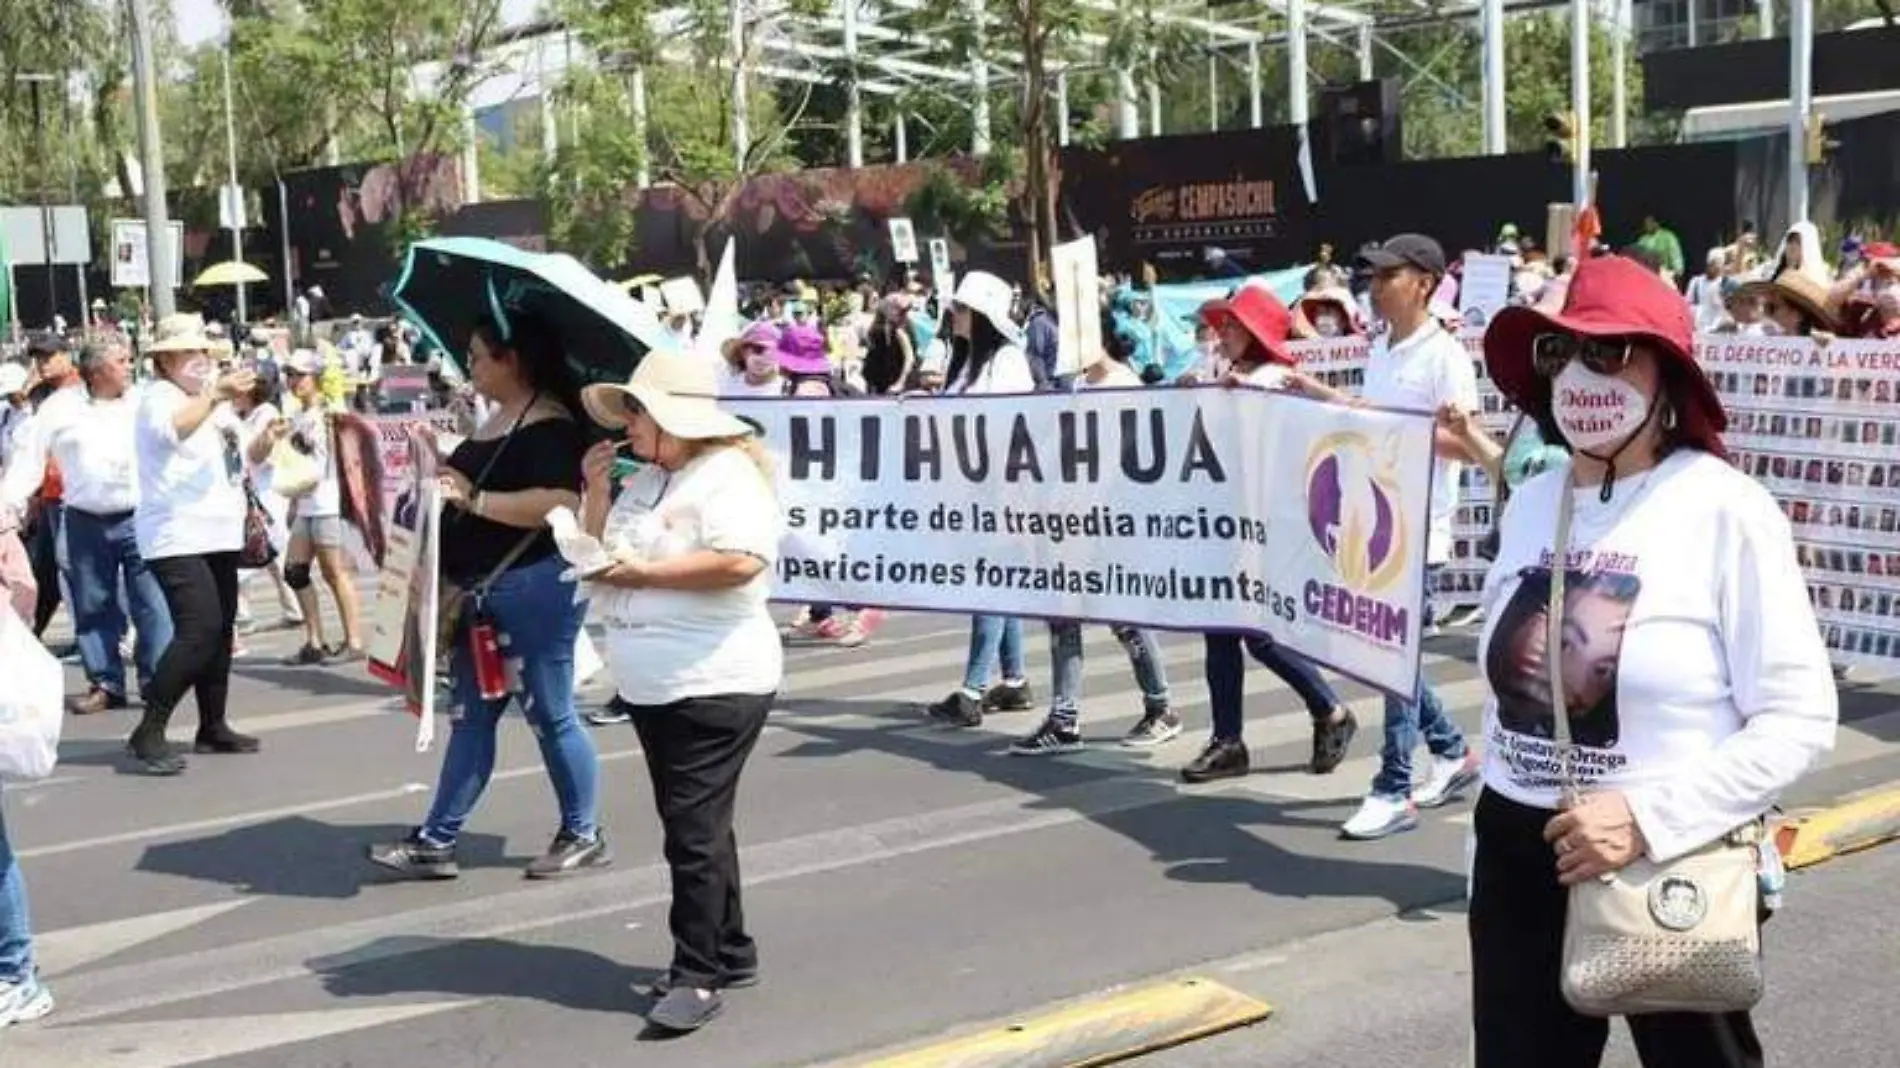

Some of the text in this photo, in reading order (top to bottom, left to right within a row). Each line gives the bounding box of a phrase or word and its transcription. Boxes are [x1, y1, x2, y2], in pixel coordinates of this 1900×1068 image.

[1724, 345, 1802, 366] DERECHO
[1808, 350, 1822, 367] A
[1828, 351, 1849, 369] LA
[818, 503, 920, 536] parte
[929, 502, 964, 531] de
[972, 503, 998, 533] la
[1004, 505, 1137, 544] tragedia
[1146, 506, 1268, 546] naciona
[776, 552, 967, 585] pariciones
[1303, 578, 1409, 646] CEDEHM
